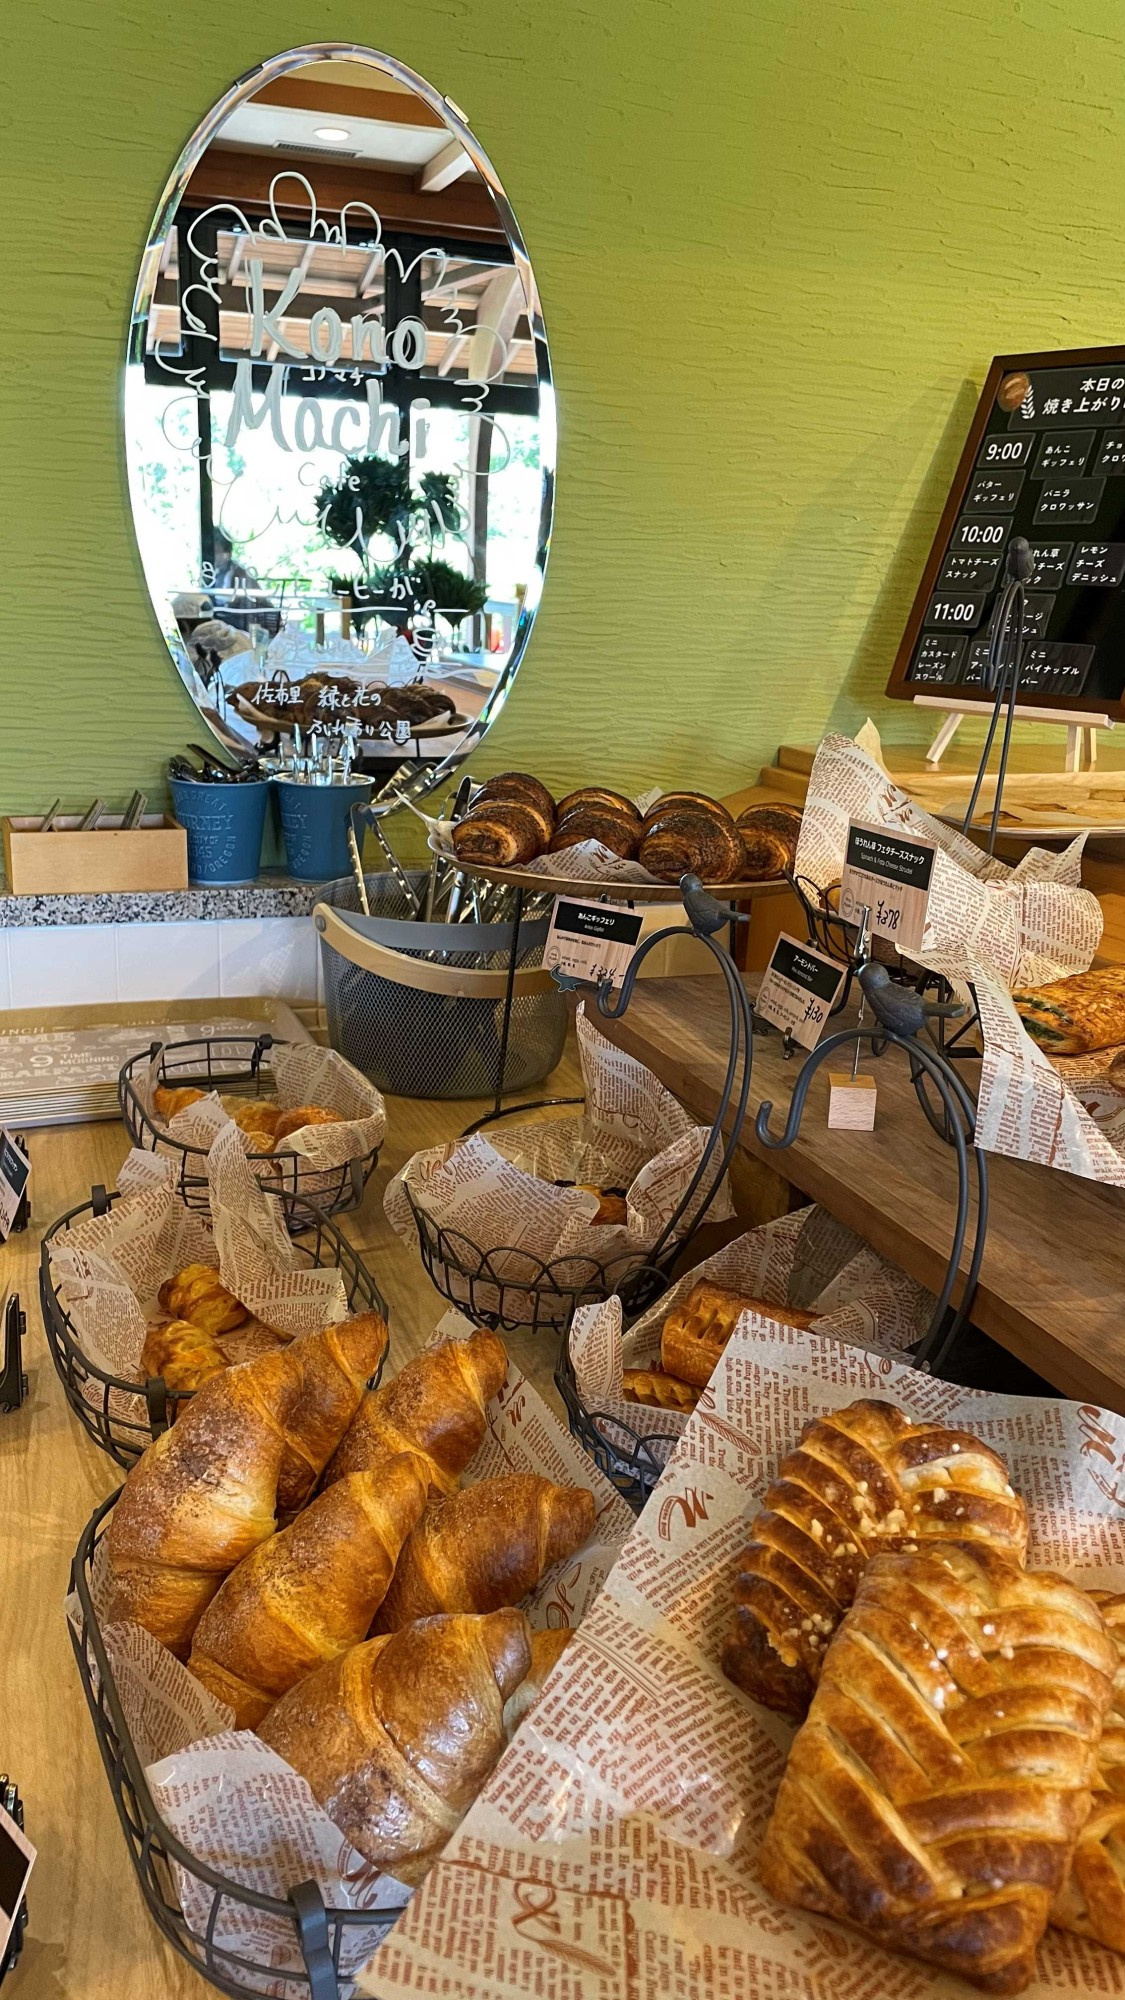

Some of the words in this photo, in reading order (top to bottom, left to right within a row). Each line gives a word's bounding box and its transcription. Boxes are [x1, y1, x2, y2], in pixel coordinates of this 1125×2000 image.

[244, 258, 428, 370] Kono
[301, 366, 364, 386] コノマチ
[1080, 377, 1125, 393] 本日の
[224, 359, 431, 459] Machi
[1042, 396, 1125, 415] 焼き上がり
[985, 442, 1023, 461] 9:00
[1045, 445, 1071, 454] あんこ
[1041, 457, 1085, 467] ギッフェリ
[298, 462, 360, 492] Cafe
[977, 480, 1002, 489] バター
[973, 493, 1015, 502] ギッフェリ
[1044, 489, 1070, 498] バニラ
[1040, 502, 1094, 512] クロワッサン
[961, 525, 1004, 543] 10:00
[1033, 548, 1060, 558] れん草
[1080, 546, 1108, 554] レモン
[951, 557, 1000, 567] トマトチーズ
[1033, 562, 1065, 571] チーズ
[1076, 559, 1105, 568] チーズ
[945, 570, 977, 579] スナック
[1072, 573, 1117, 583] デニッシュ
[934, 603, 974, 621] 11:00
[925, 638, 938, 646] ミニ
[920, 650, 957, 659] カスタード
[1030, 650, 1046, 659] ミニ
[918, 662, 946, 670] レーズン
[914, 672, 943, 681] スワール
[1021, 677, 1038, 685] バー
[251, 681, 304, 705] 佐布里
[29, 1054, 53, 1068] 9
[1054, 1474, 1065, 1510] brother
[1063, 1480, 1074, 1502] year
[1047, 1510, 1059, 1535] stock
[1068, 1506, 1077, 1532] older
[1038, 1514, 1048, 1537] New
[1029, 1528, 1041, 1546] had
[1041, 1540, 1053, 1565] York
[1071, 1536, 1081, 1559] than
